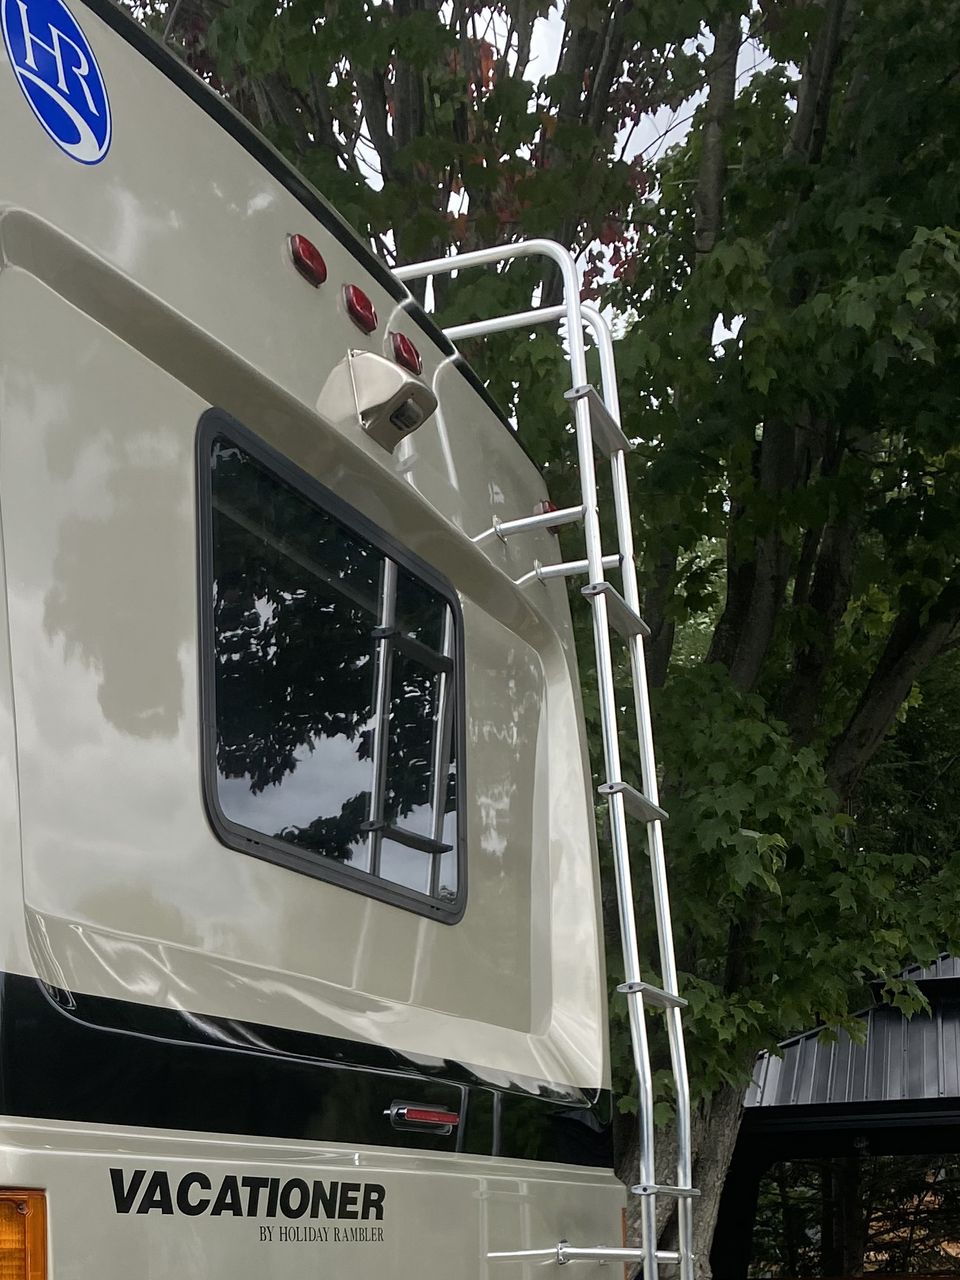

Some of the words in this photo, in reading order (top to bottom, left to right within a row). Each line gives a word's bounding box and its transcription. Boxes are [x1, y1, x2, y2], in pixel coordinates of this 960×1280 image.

[16, 0, 100, 118] HR
[108, 1167, 386, 1221] VACATIONER
[259, 1226, 273, 1242] BY
[279, 1226, 330, 1242] HOLIDAY
[334, 1226, 385, 1243] RAMBLER
